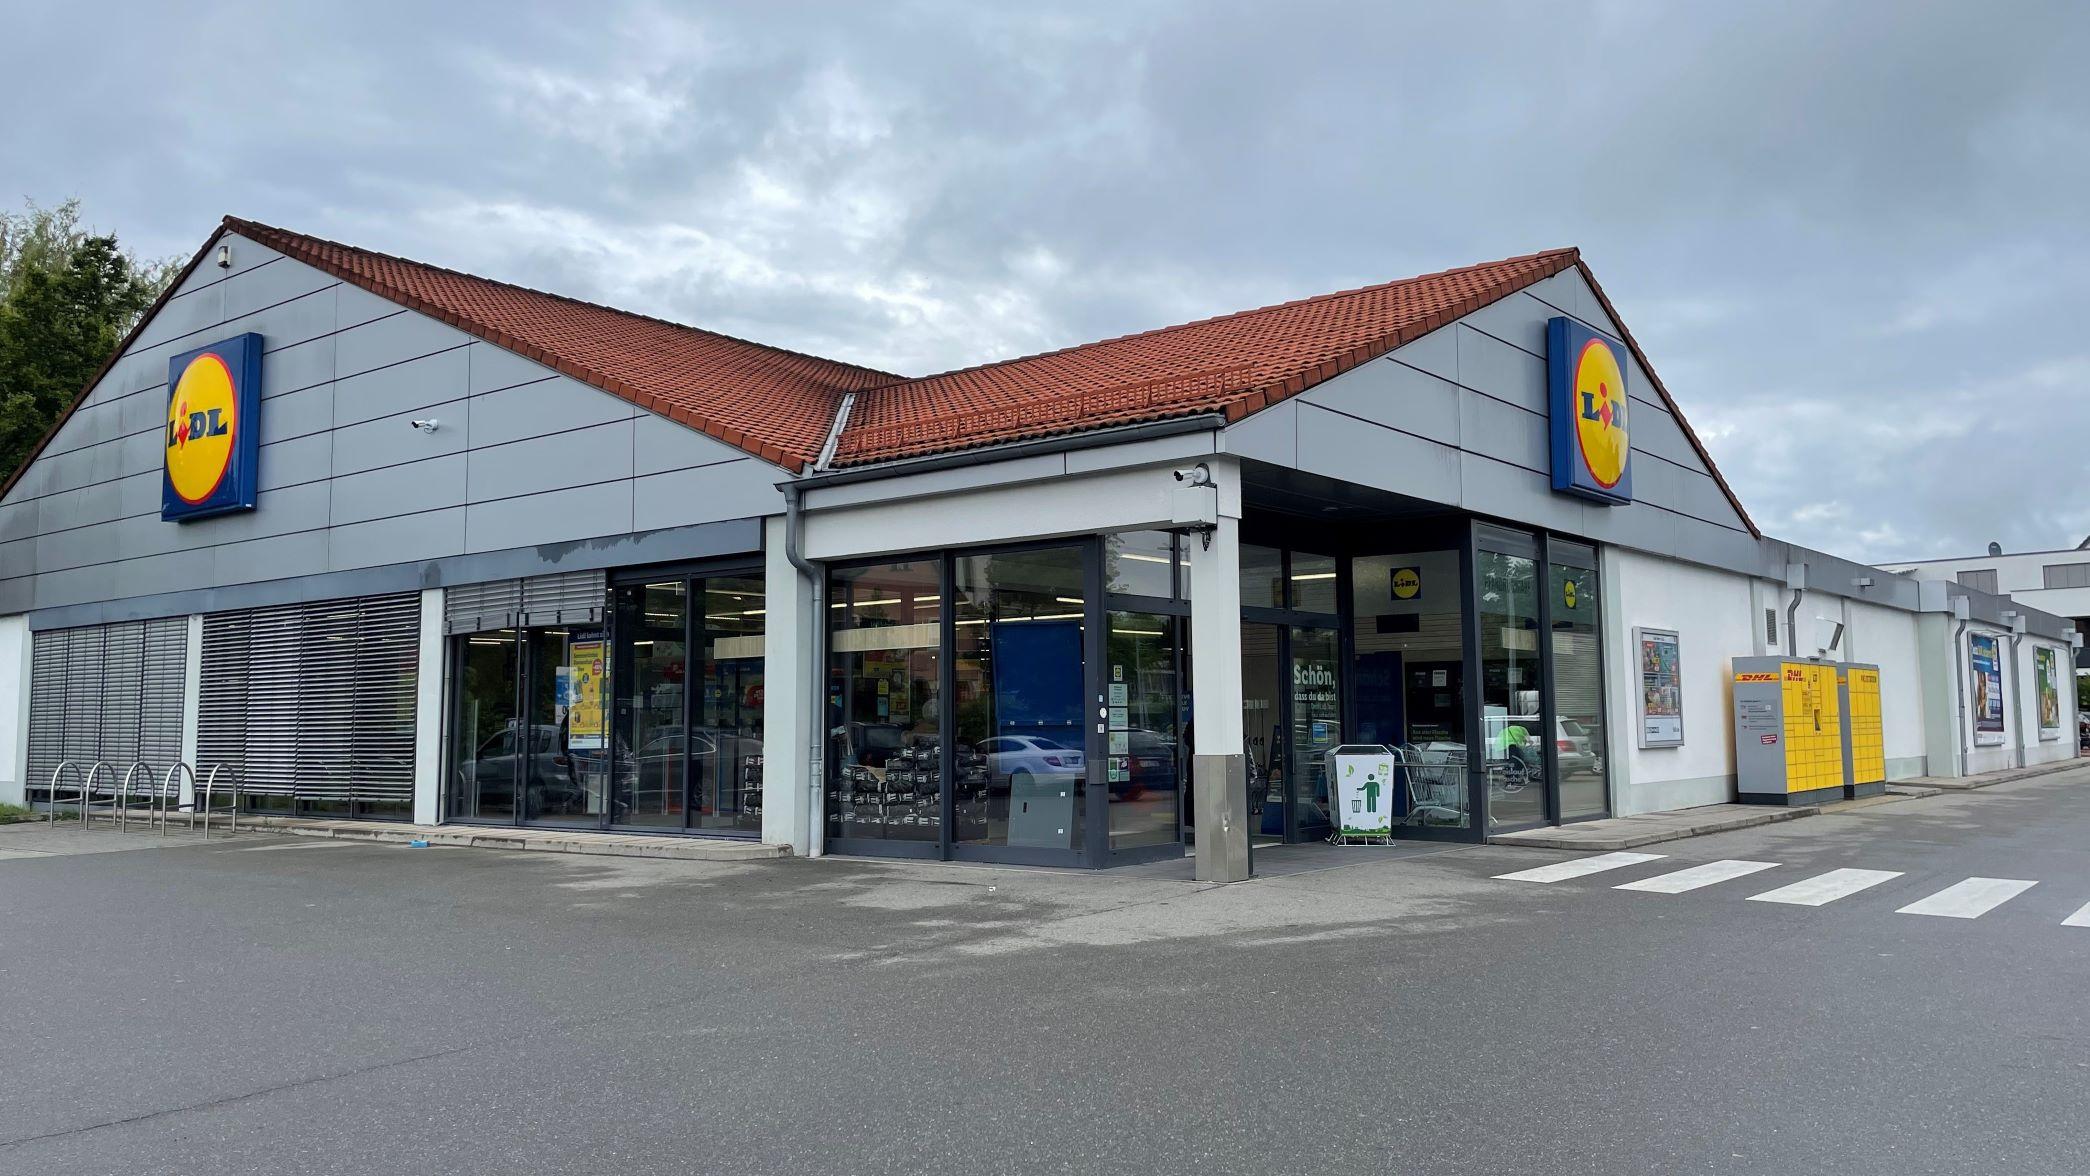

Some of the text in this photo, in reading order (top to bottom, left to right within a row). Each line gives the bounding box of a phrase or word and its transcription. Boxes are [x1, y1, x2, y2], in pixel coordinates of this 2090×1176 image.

[1581, 382, 1628, 431] LiD
[1294, 664, 1336, 689] Schön,
[1294, 691, 1308, 701] dass
[1308, 691, 1317, 701] du
